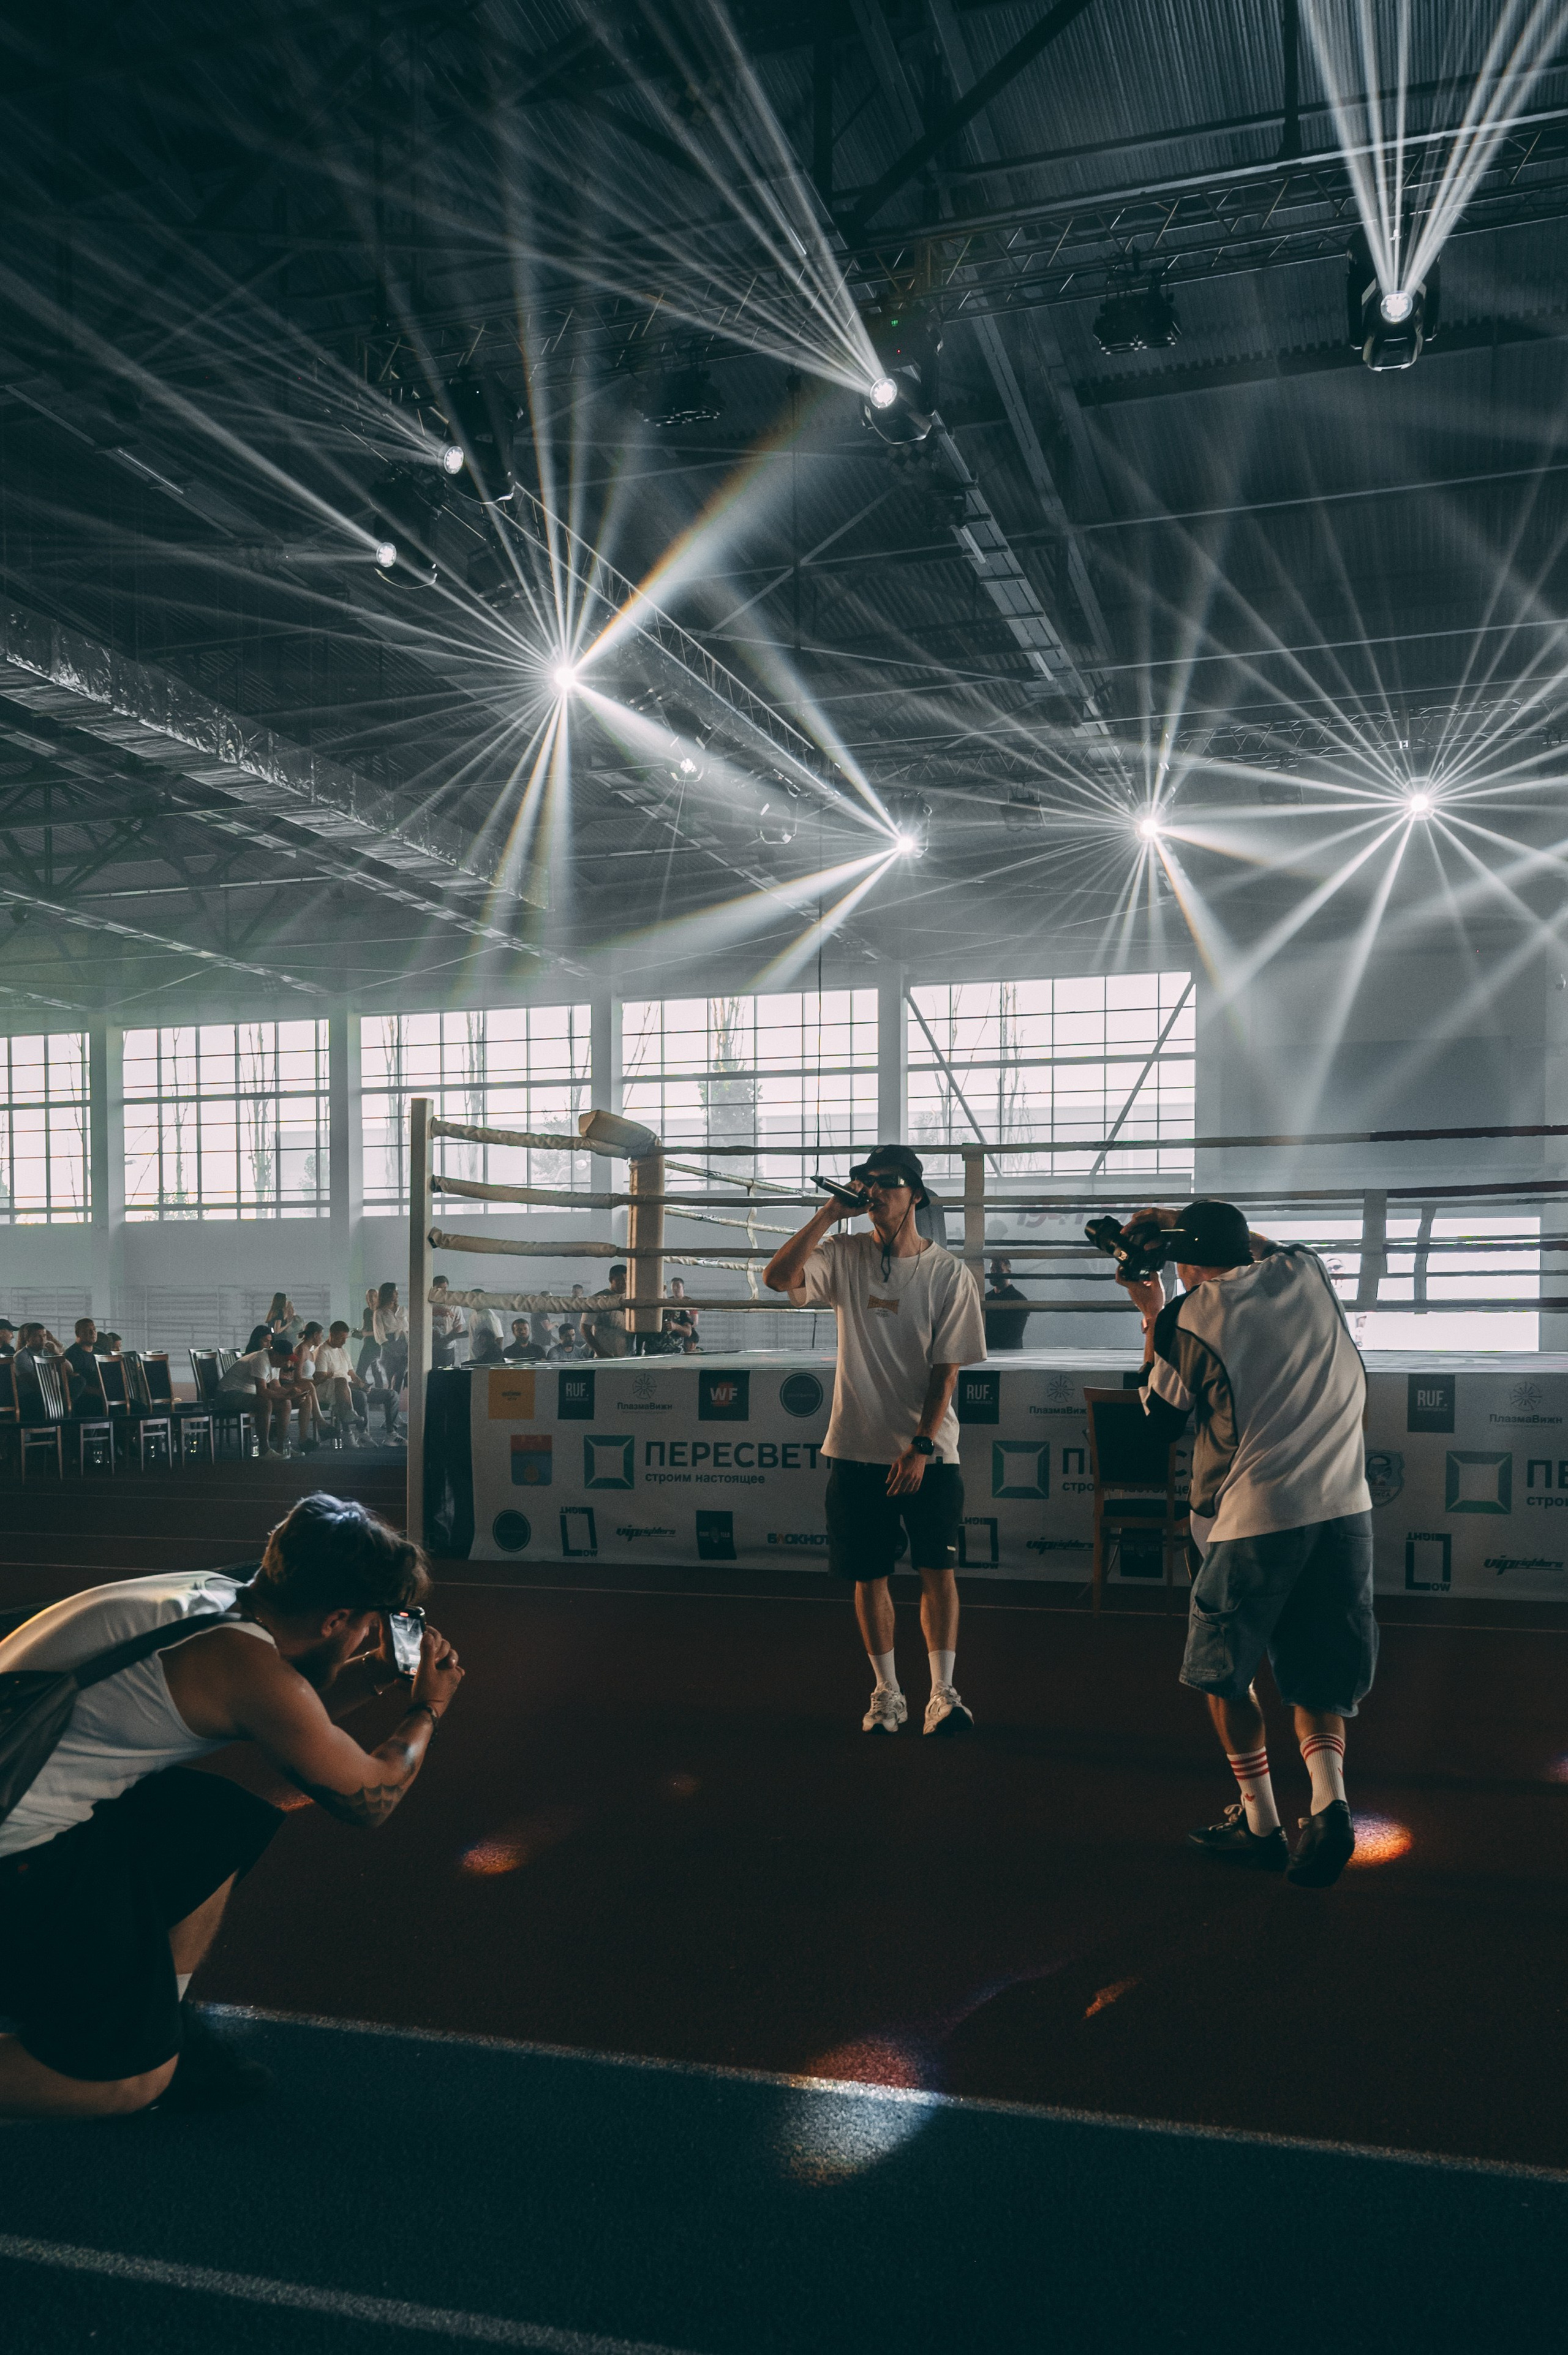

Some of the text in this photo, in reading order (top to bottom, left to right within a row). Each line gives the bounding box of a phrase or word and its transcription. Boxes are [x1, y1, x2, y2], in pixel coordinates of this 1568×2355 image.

[710, 1387, 738, 1401] WF
[617, 1402, 673, 1410] ПлазмаВижн
[1029, 1405, 1087, 1414] ПлазмаВиж
[1489, 1413, 1563, 1424] ПлазмаВижн
[645, 1442, 823, 1469] ПЕРЕСВЕТ
[645, 1473, 765, 1485] строим настоящее
